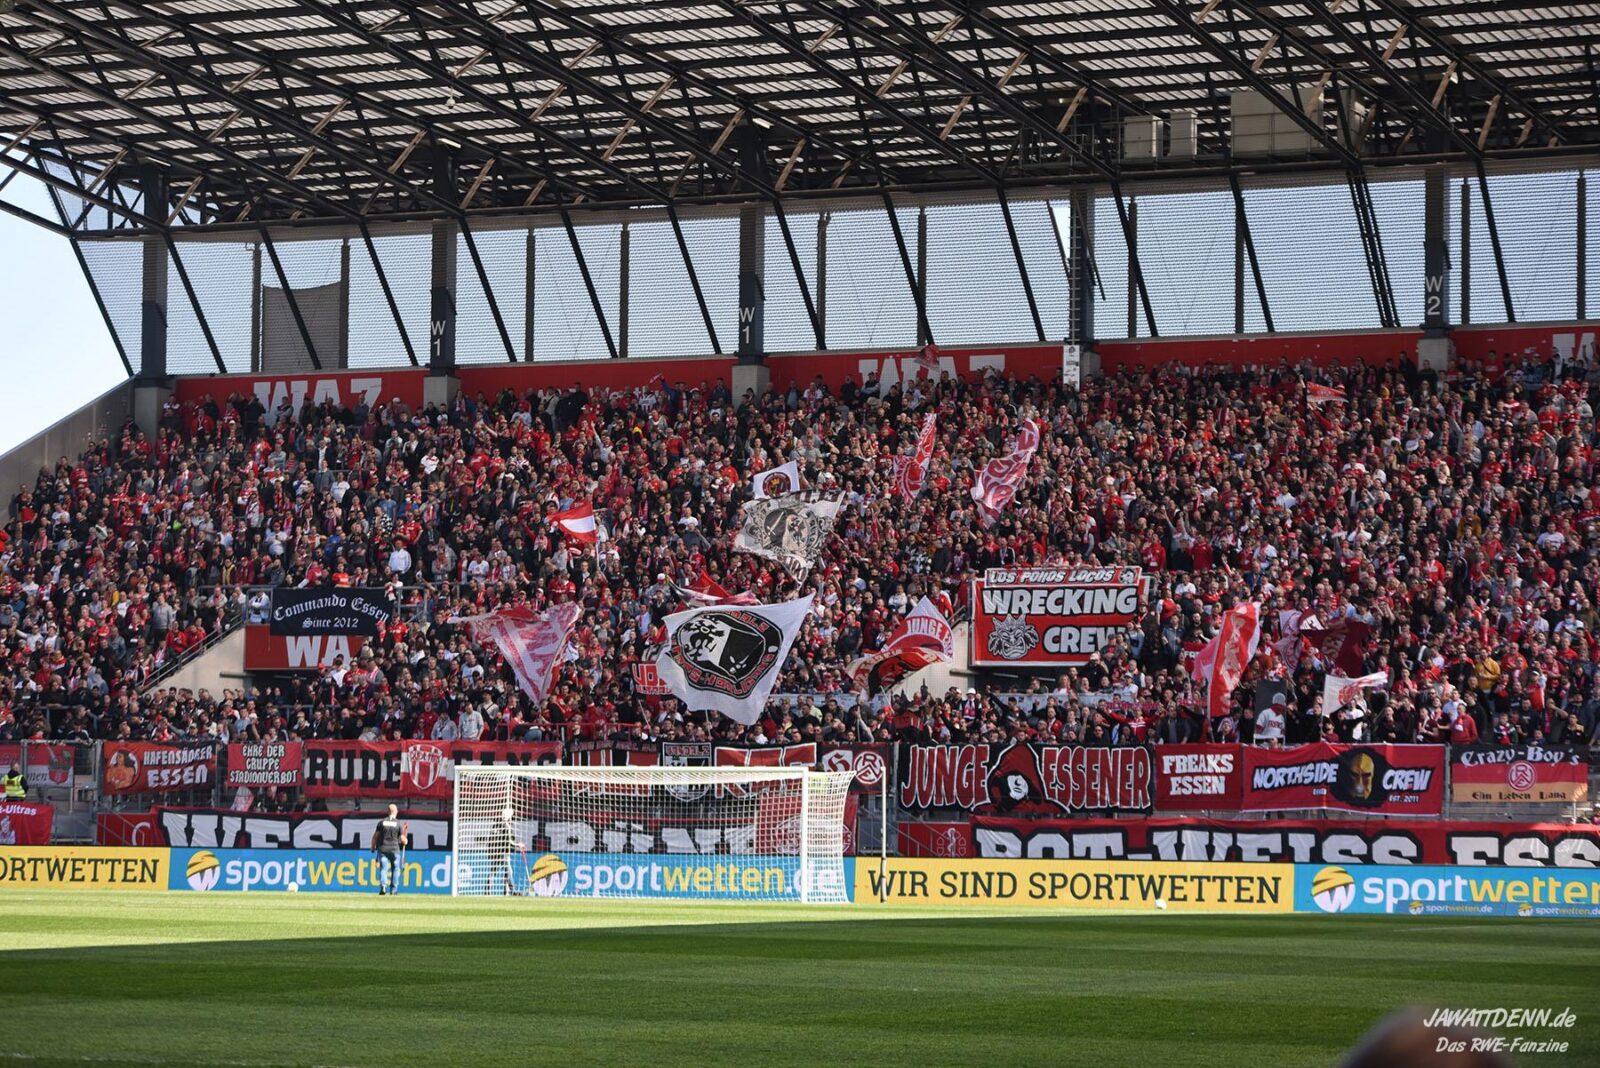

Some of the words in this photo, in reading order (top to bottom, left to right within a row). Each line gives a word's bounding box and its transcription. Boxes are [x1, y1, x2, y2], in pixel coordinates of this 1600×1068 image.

[1425, 276, 1443, 292] W
[739, 307, 755, 322] W
[1427, 295, 1441, 316] 2
[431, 320, 446, 336] W
[989, 569, 1017, 584] LOS
[273, 593, 347, 621] Commando
[350, 596, 390, 623] Essen
[982, 588, 1138, 615] WRECKING
[301, 616, 331, 629] Since
[333, 616, 360, 629] 2012
[285, 635, 352, 668] WA
[1043, 626, 1128, 654] CREW
[242, 744, 263, 758] EHRE
[266, 745, 285, 757] DER
[246, 758, 280, 770] GRUPPE
[306, 750, 401, 789] RUDE
[1162, 753, 1235, 774] FREAKS
[147, 763, 208, 789] ESSEN
[901, 743, 991, 809] JUNGE
[1041, 745, 1152, 810] ESSENER
[1169, 775, 1226, 796] ESSEN
[1252, 761, 1339, 791] NORTHSIDE
[1382, 768, 1432, 791] CREW
[0, 857, 160, 883] RTWETTEN
[868, 870, 929, 897] WIR
[940, 871, 1018, 899] SIND
[1028, 872, 1282, 905] SPORTWETTEN
